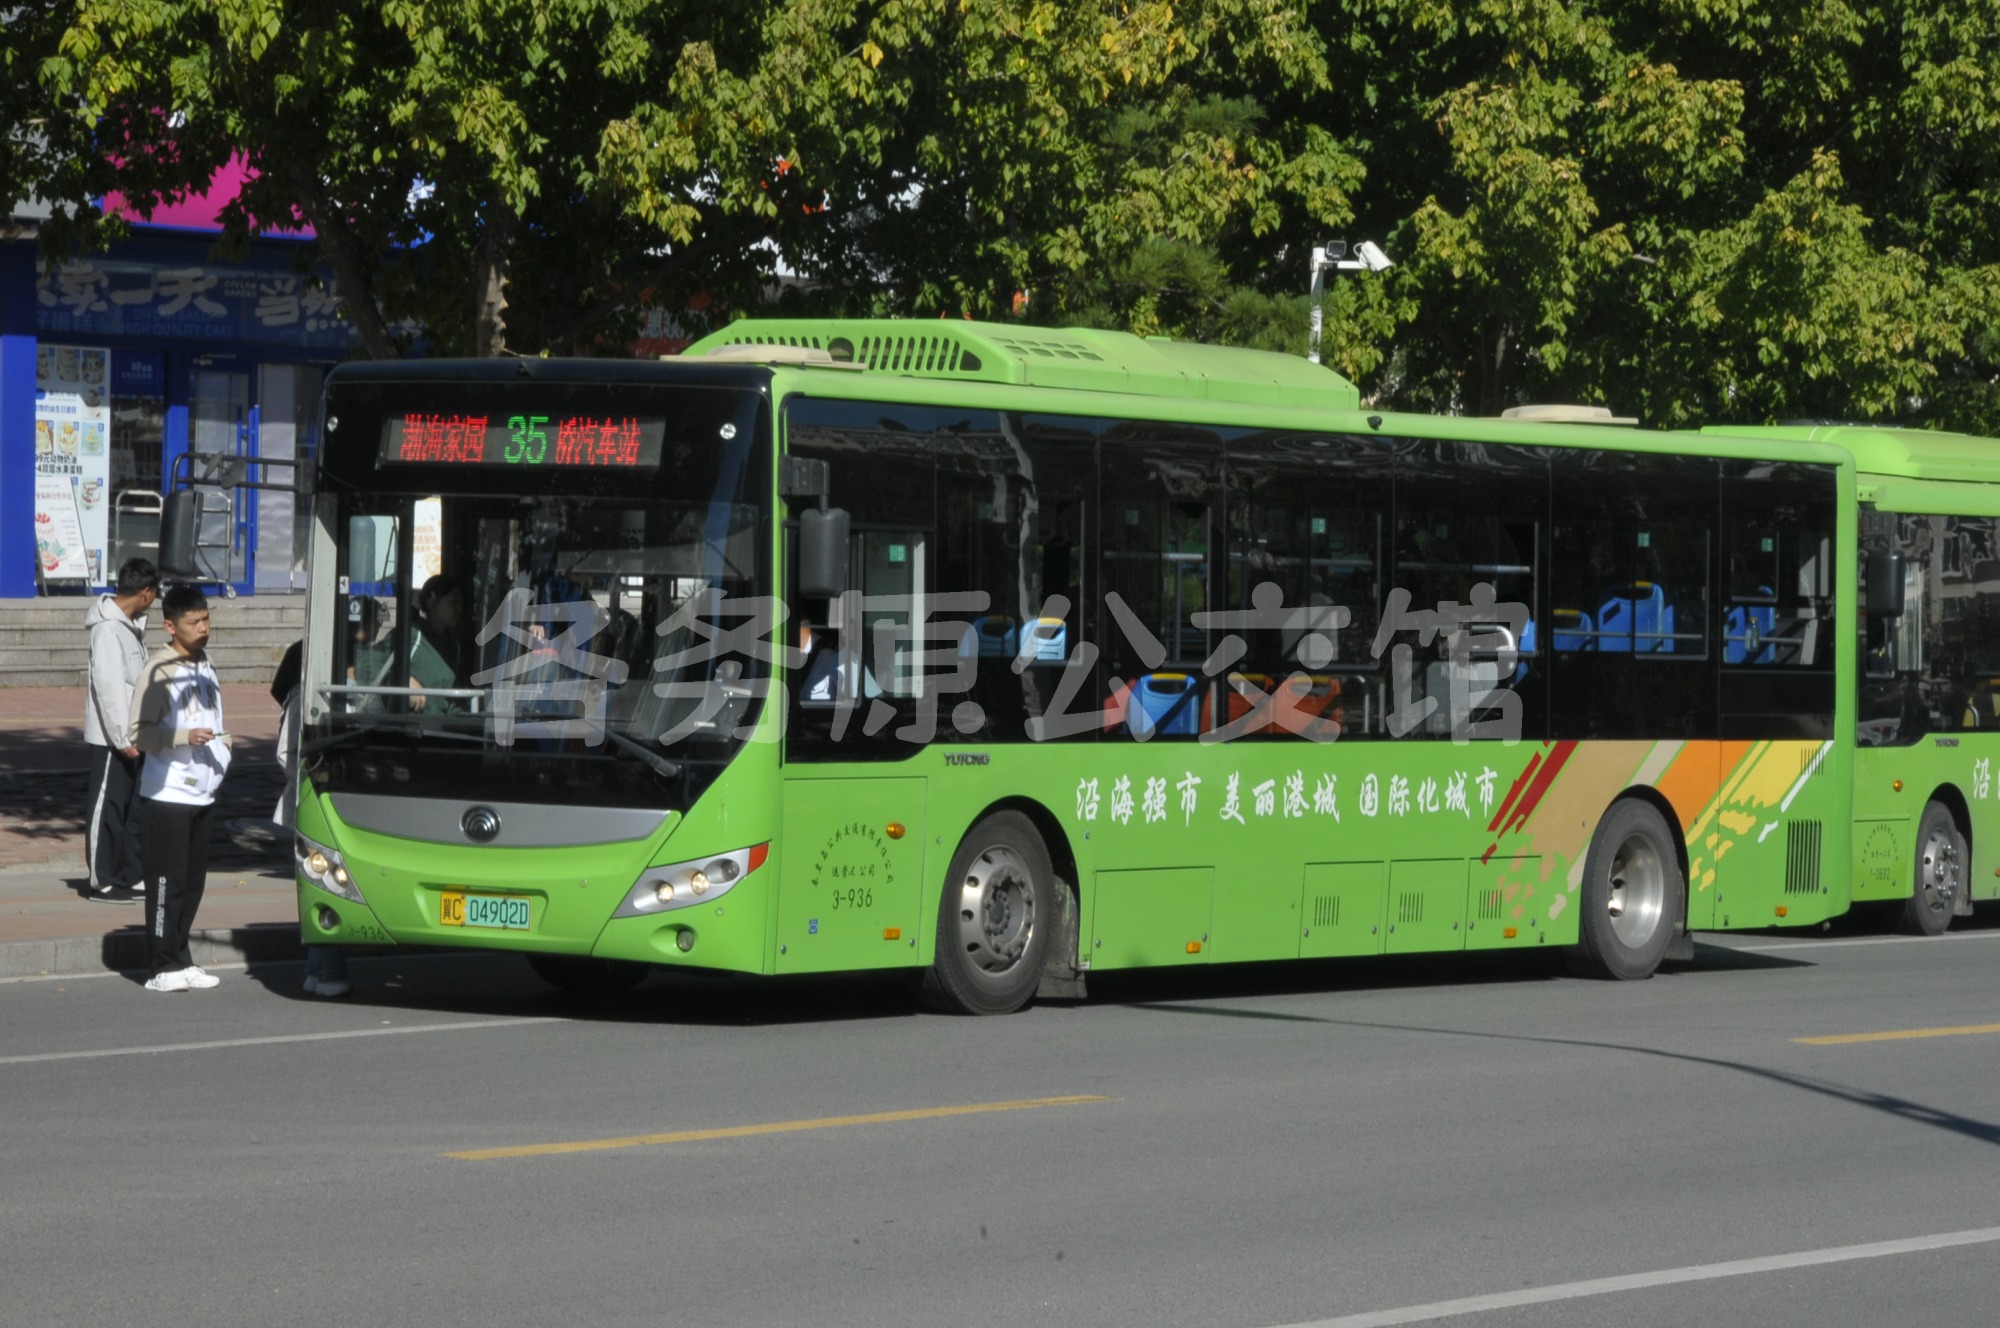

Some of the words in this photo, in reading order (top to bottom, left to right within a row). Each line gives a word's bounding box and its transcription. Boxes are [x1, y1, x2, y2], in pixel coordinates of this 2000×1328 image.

[154, 323, 201, 336] QUALITY
[504, 415, 549, 464] 35
[943, 752, 991, 766] YUTONG
[1076, 771, 1202, 827] 沿海强市
[1219, 769, 1340, 825] 美丽港城
[1359, 765, 1498, 819] 国际化城市
[832, 887, 873, 910] 3-936
[347, 924, 385, 940] 3-936
